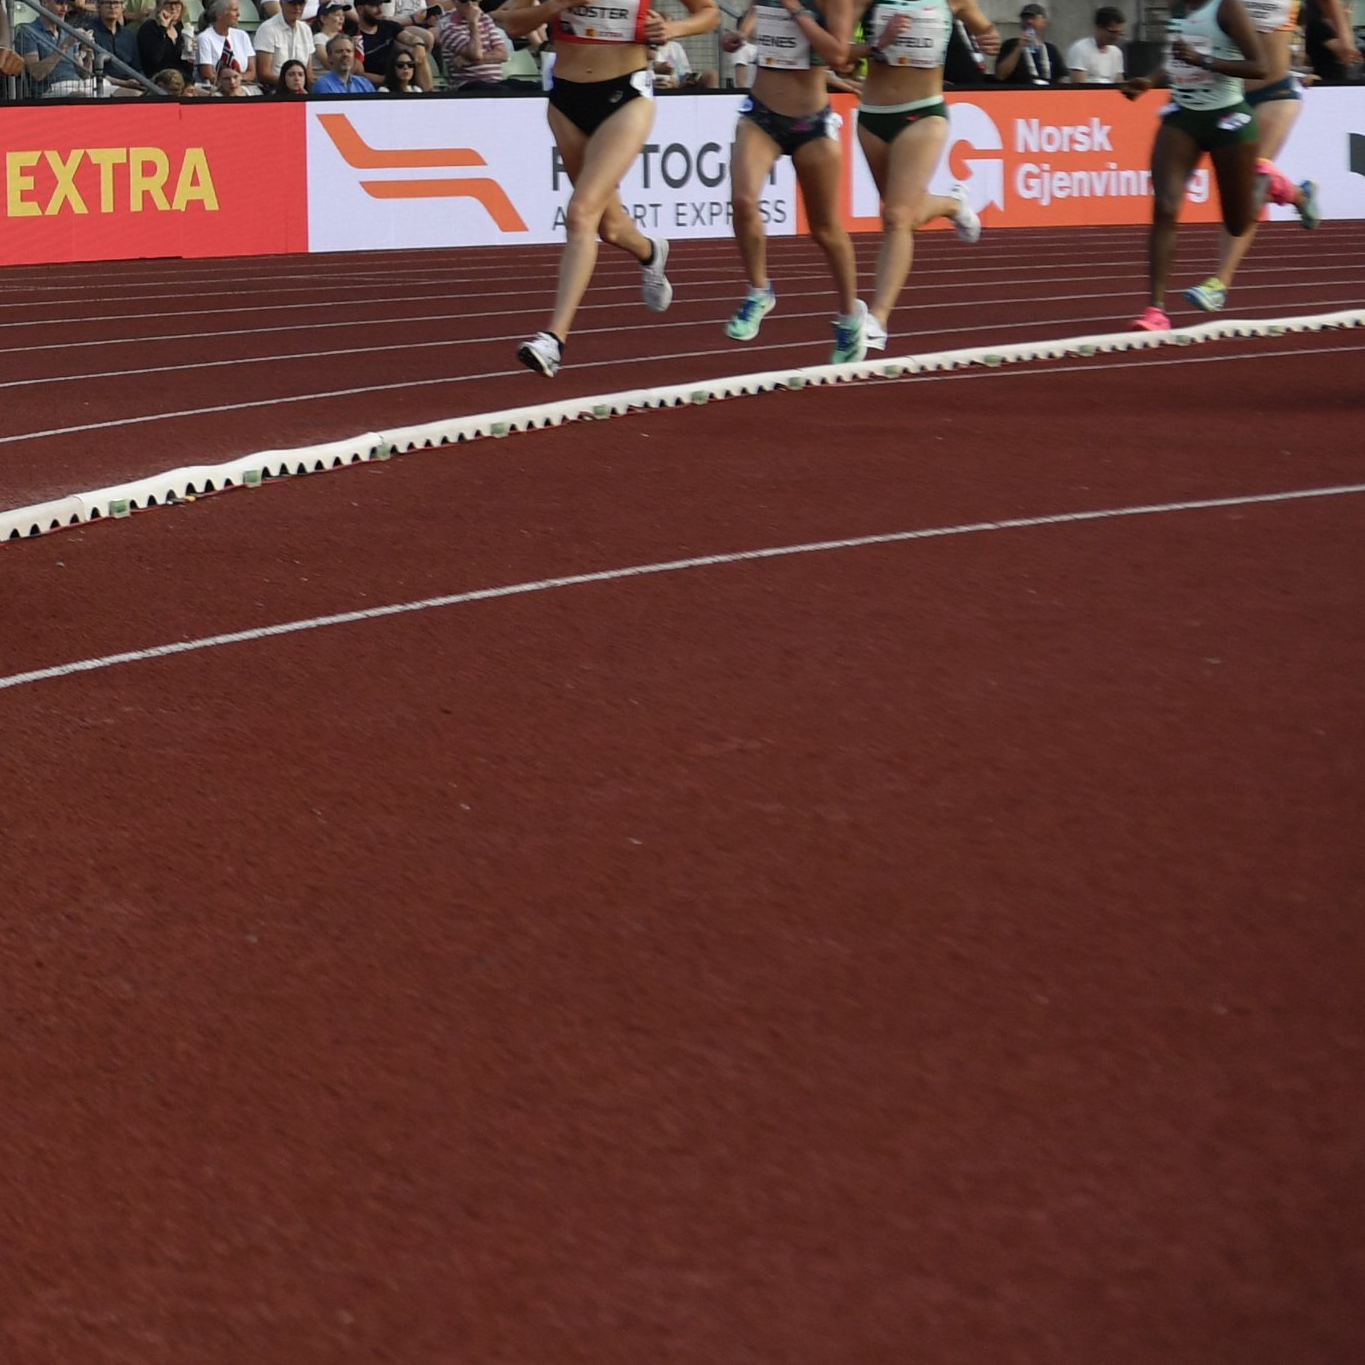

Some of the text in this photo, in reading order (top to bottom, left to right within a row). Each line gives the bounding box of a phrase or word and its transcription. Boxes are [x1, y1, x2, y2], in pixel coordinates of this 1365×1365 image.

[1015, 117, 1113, 153] Norsk
[5, 146, 220, 217] EXTRA
[551, 142, 777, 191] FTOG
[1015, 162, 1210, 206] Gjenvinng
[676, 199, 787, 227] EXPSS
